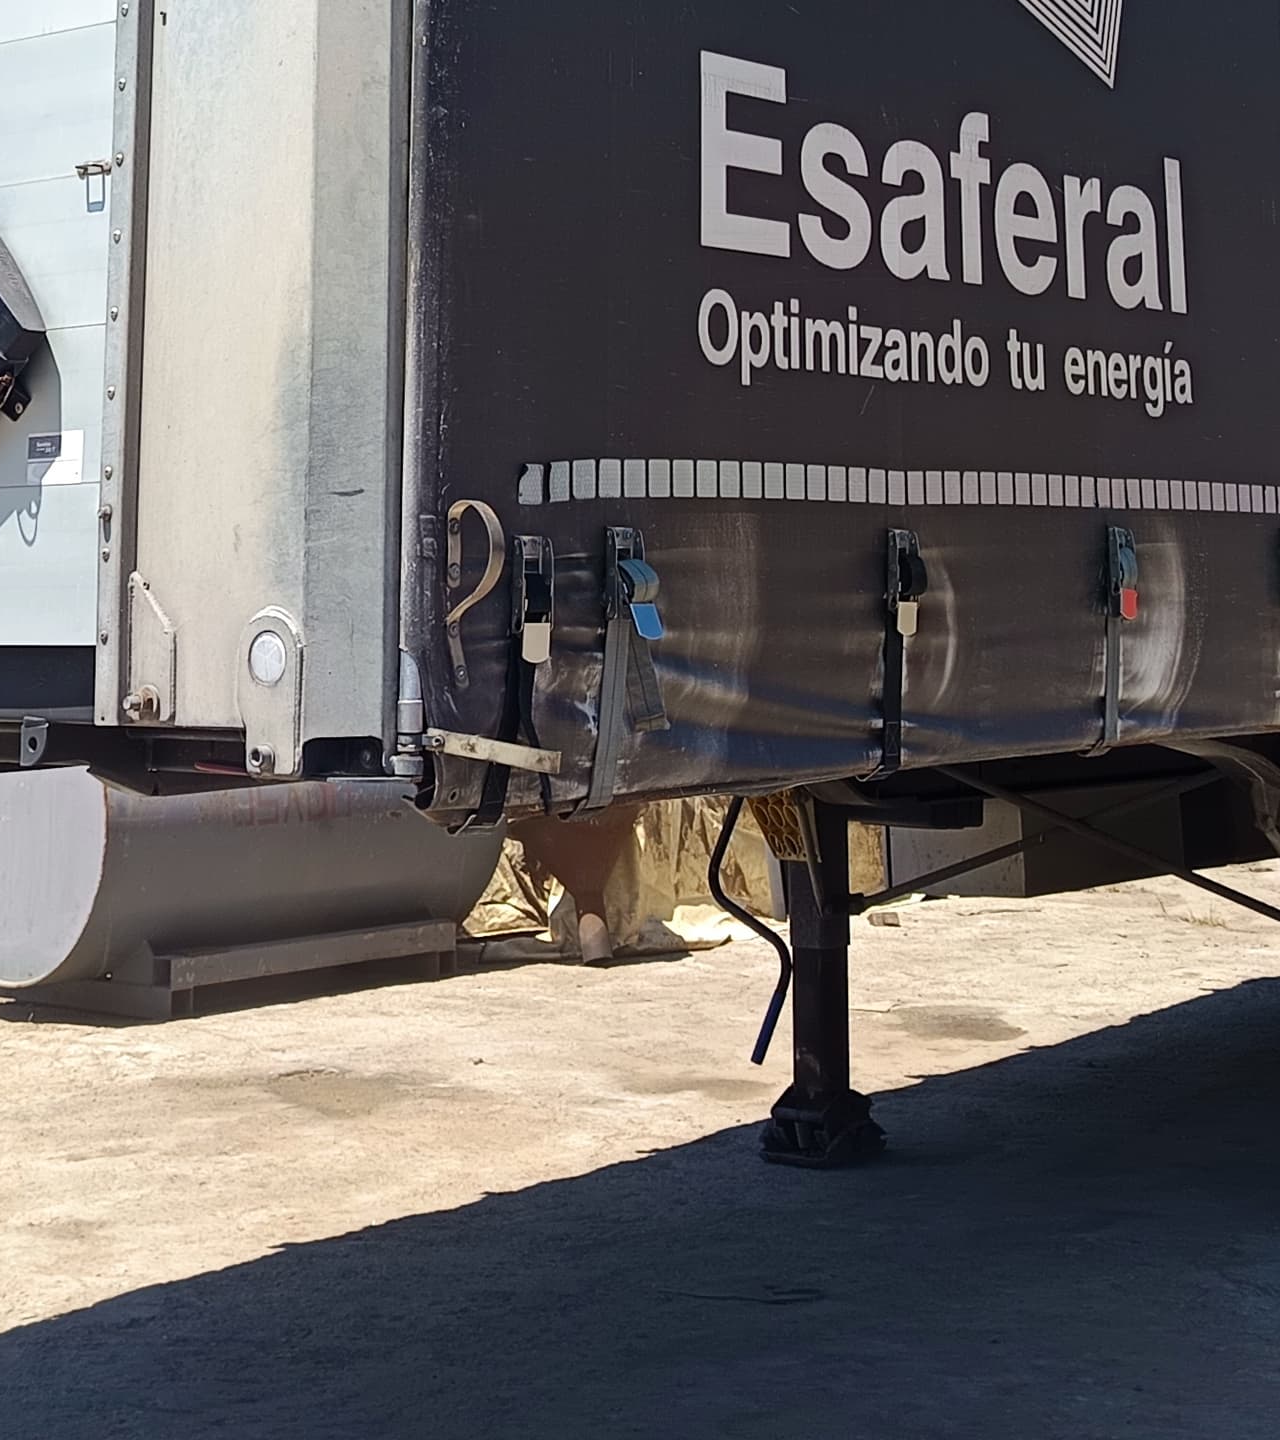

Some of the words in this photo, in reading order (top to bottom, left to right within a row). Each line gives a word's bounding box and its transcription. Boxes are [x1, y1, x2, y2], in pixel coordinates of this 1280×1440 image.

[700, 49, 1188, 315] Esaferal
[697, 288, 990, 387] Optimizando
[1007, 329, 1046, 392] tu
[1063, 341, 1194, 419] energía
